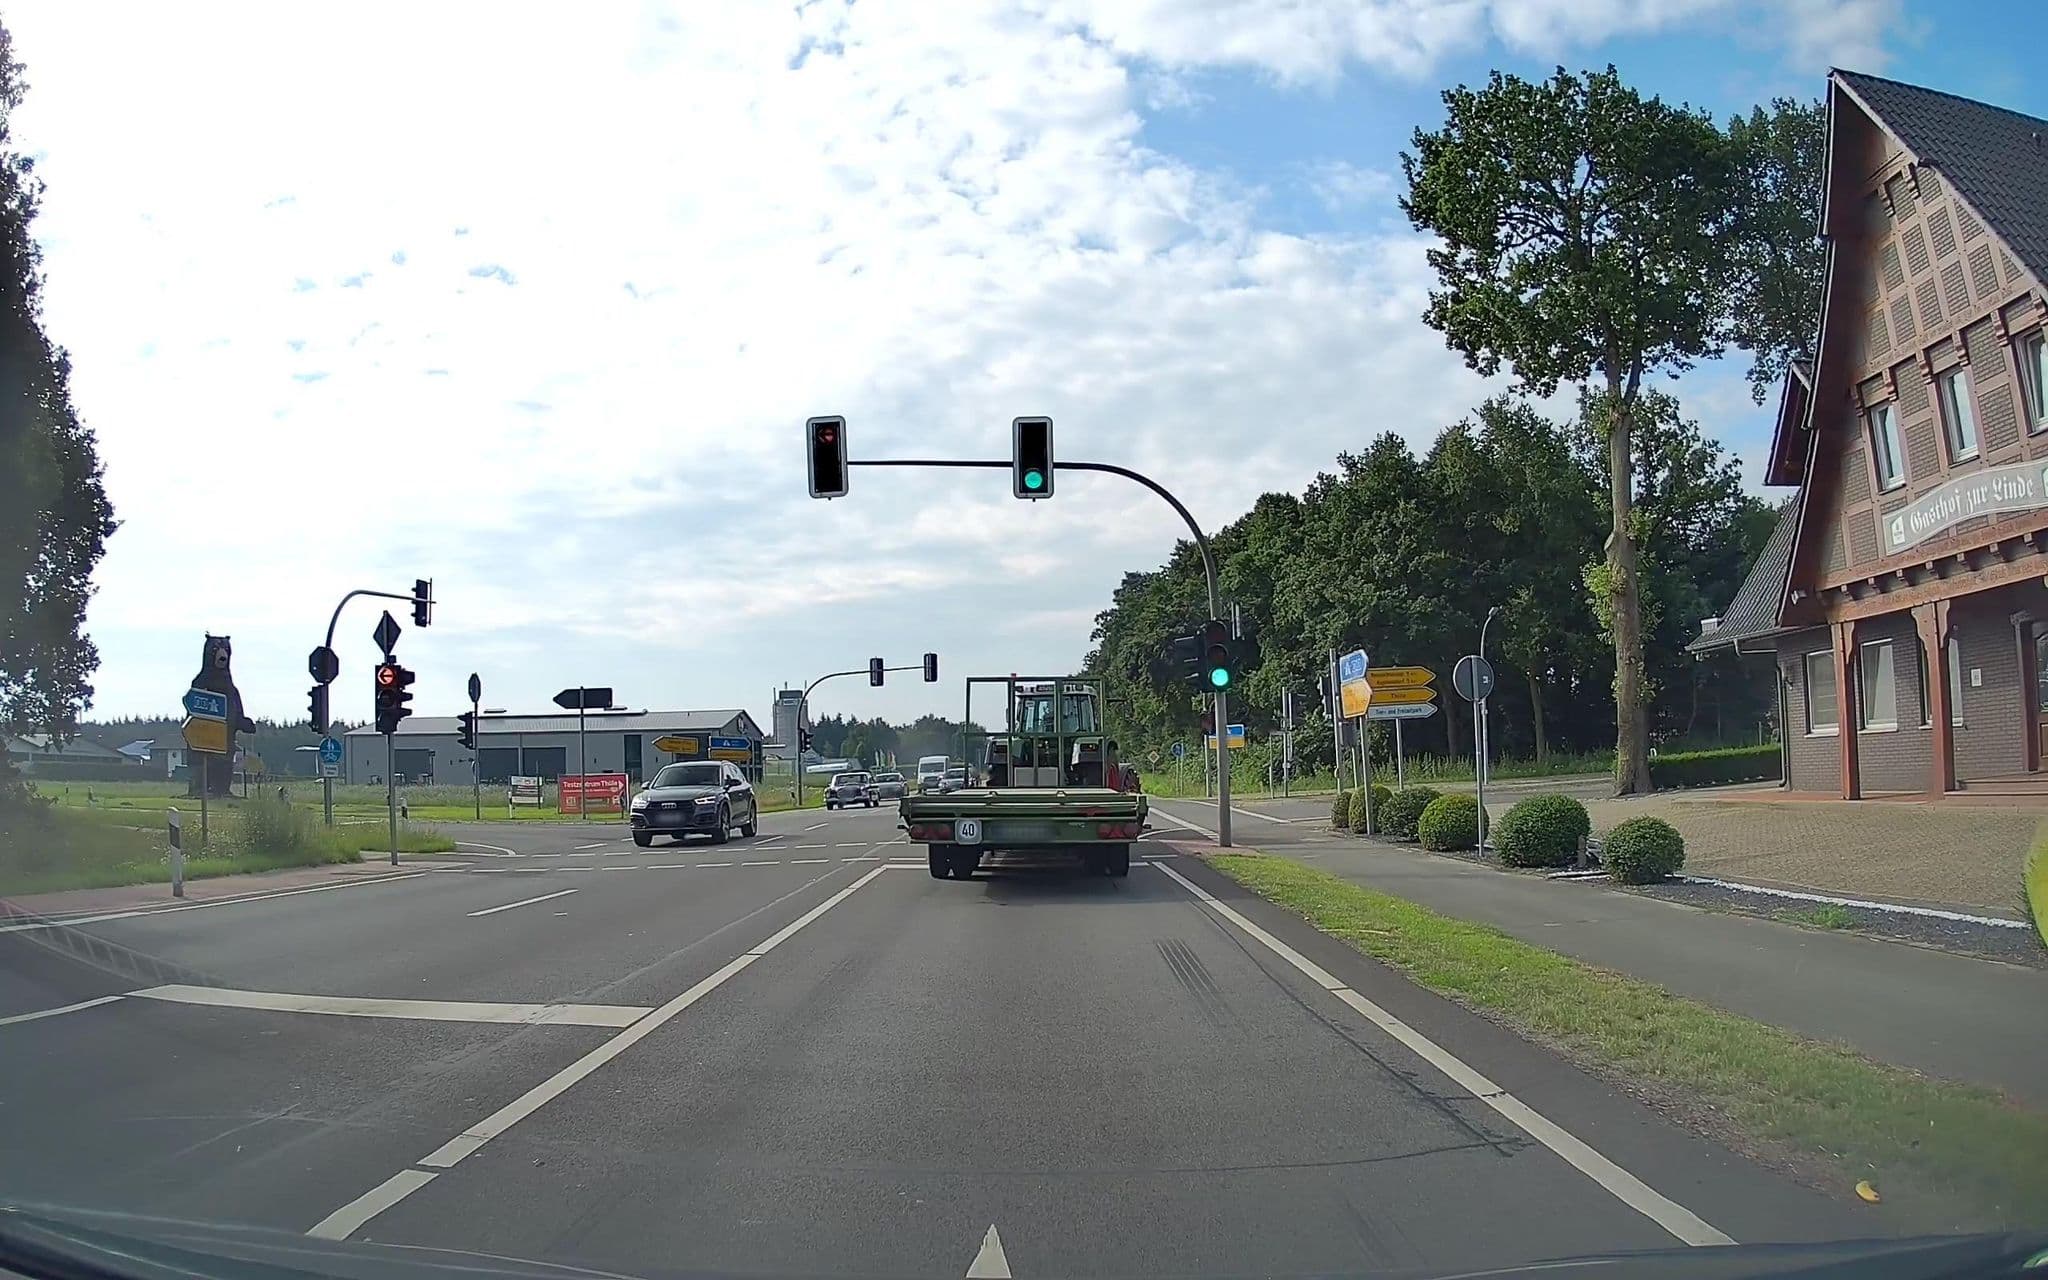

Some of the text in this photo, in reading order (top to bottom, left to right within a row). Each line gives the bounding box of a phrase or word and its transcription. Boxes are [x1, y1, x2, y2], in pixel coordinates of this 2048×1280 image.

[1910, 487, 1961, 534] Gasthof
[1966, 485, 1988, 514] zur
[1993, 475, 2033, 501] Linde
[961, 823, 975, 837] 40
